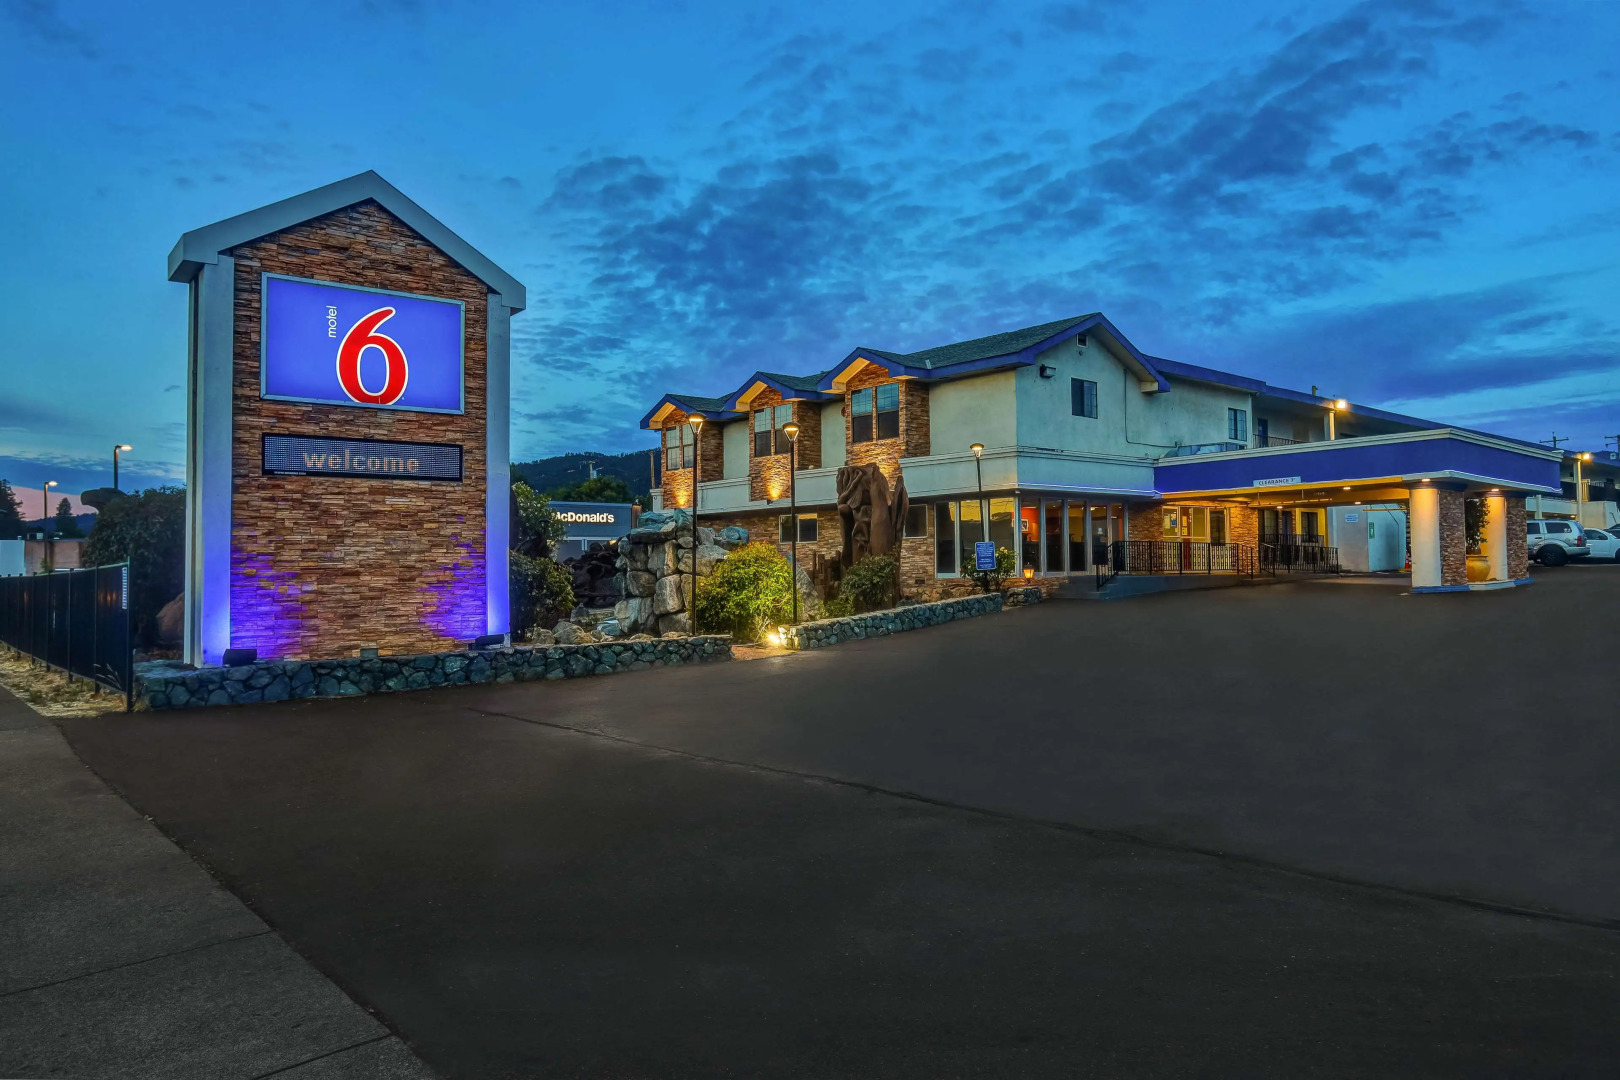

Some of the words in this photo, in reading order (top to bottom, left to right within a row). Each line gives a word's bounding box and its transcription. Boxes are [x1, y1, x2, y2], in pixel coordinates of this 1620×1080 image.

[326, 305, 337, 338] motel
[336, 306, 409, 405] 6
[304, 449, 419, 473] welcome
[1258, 478, 1290, 486] CLEARANCE
